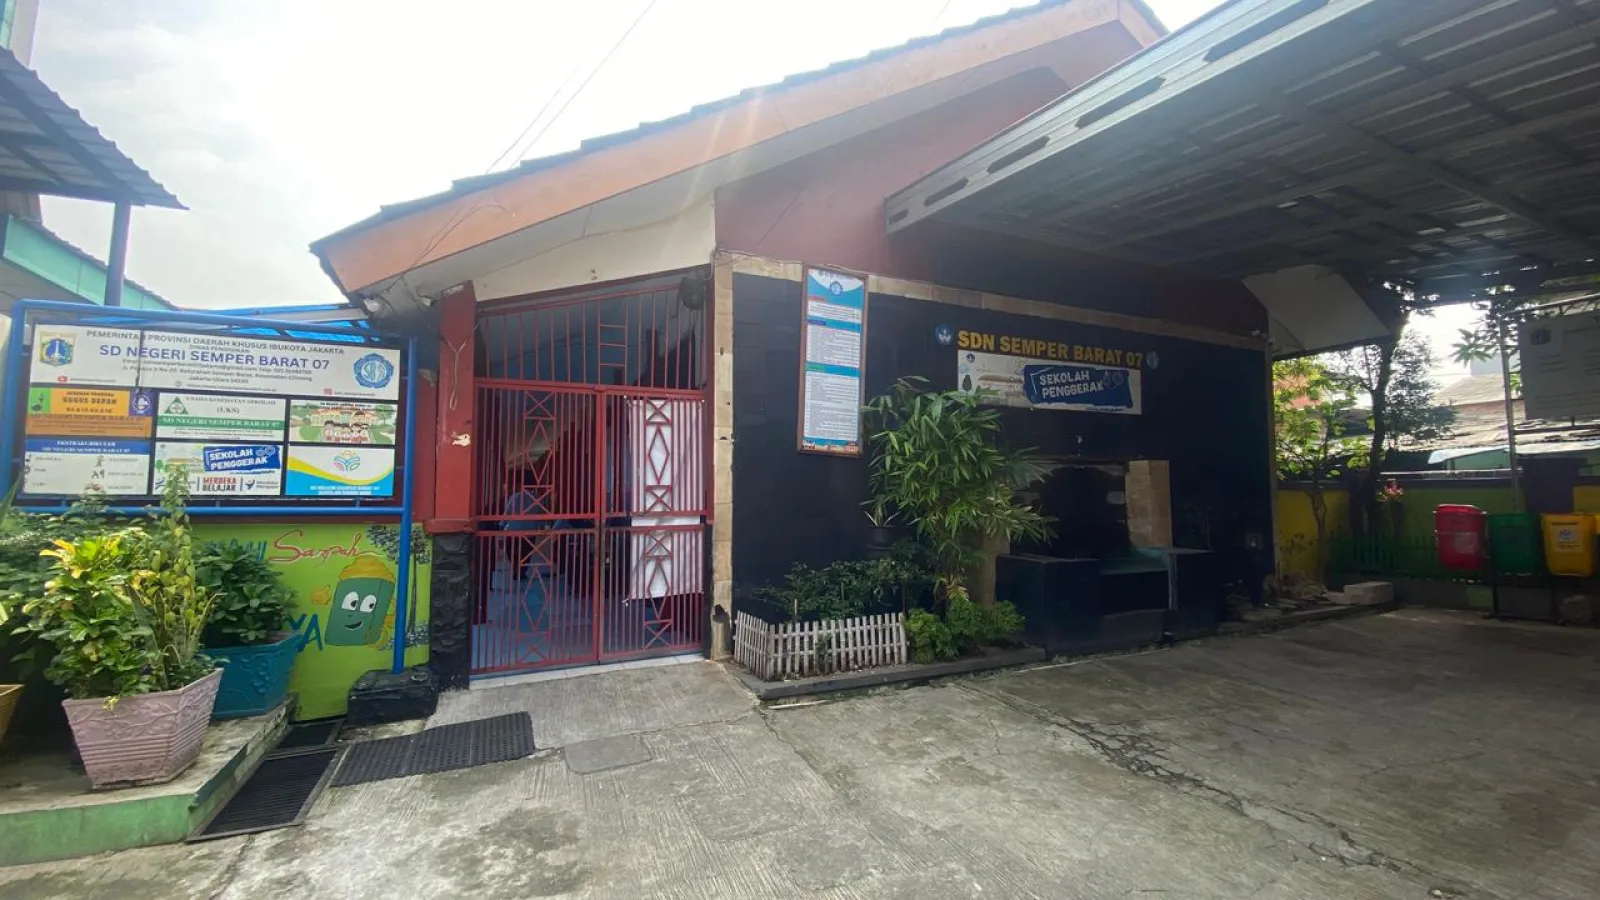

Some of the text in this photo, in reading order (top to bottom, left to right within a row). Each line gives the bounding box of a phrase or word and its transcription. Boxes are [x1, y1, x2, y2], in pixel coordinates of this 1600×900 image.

[86, 330, 345, 354] PEMERINTA PROVINSI DAERAH KHUSUS IBUKOTA JAKARTA
[958, 330, 1143, 367] SDN SEMPER BARAT 07
[99, 345, 121, 356] SD
[126, 346, 186, 361] NEGERI
[190, 350, 255, 365] SEMPER
[259, 355, 309, 369] BARAT
[312, 359, 330, 370] 07
[1039, 369, 1090, 386] SEKOLAH
[1041, 379, 1104, 399] PENGGERAK
[209, 447, 253, 461] SEKOLAH
[210, 456, 268, 471] PENGGERAK
[203, 476, 237, 485] MERDEKA
[269, 529, 374, 566] Sampah
